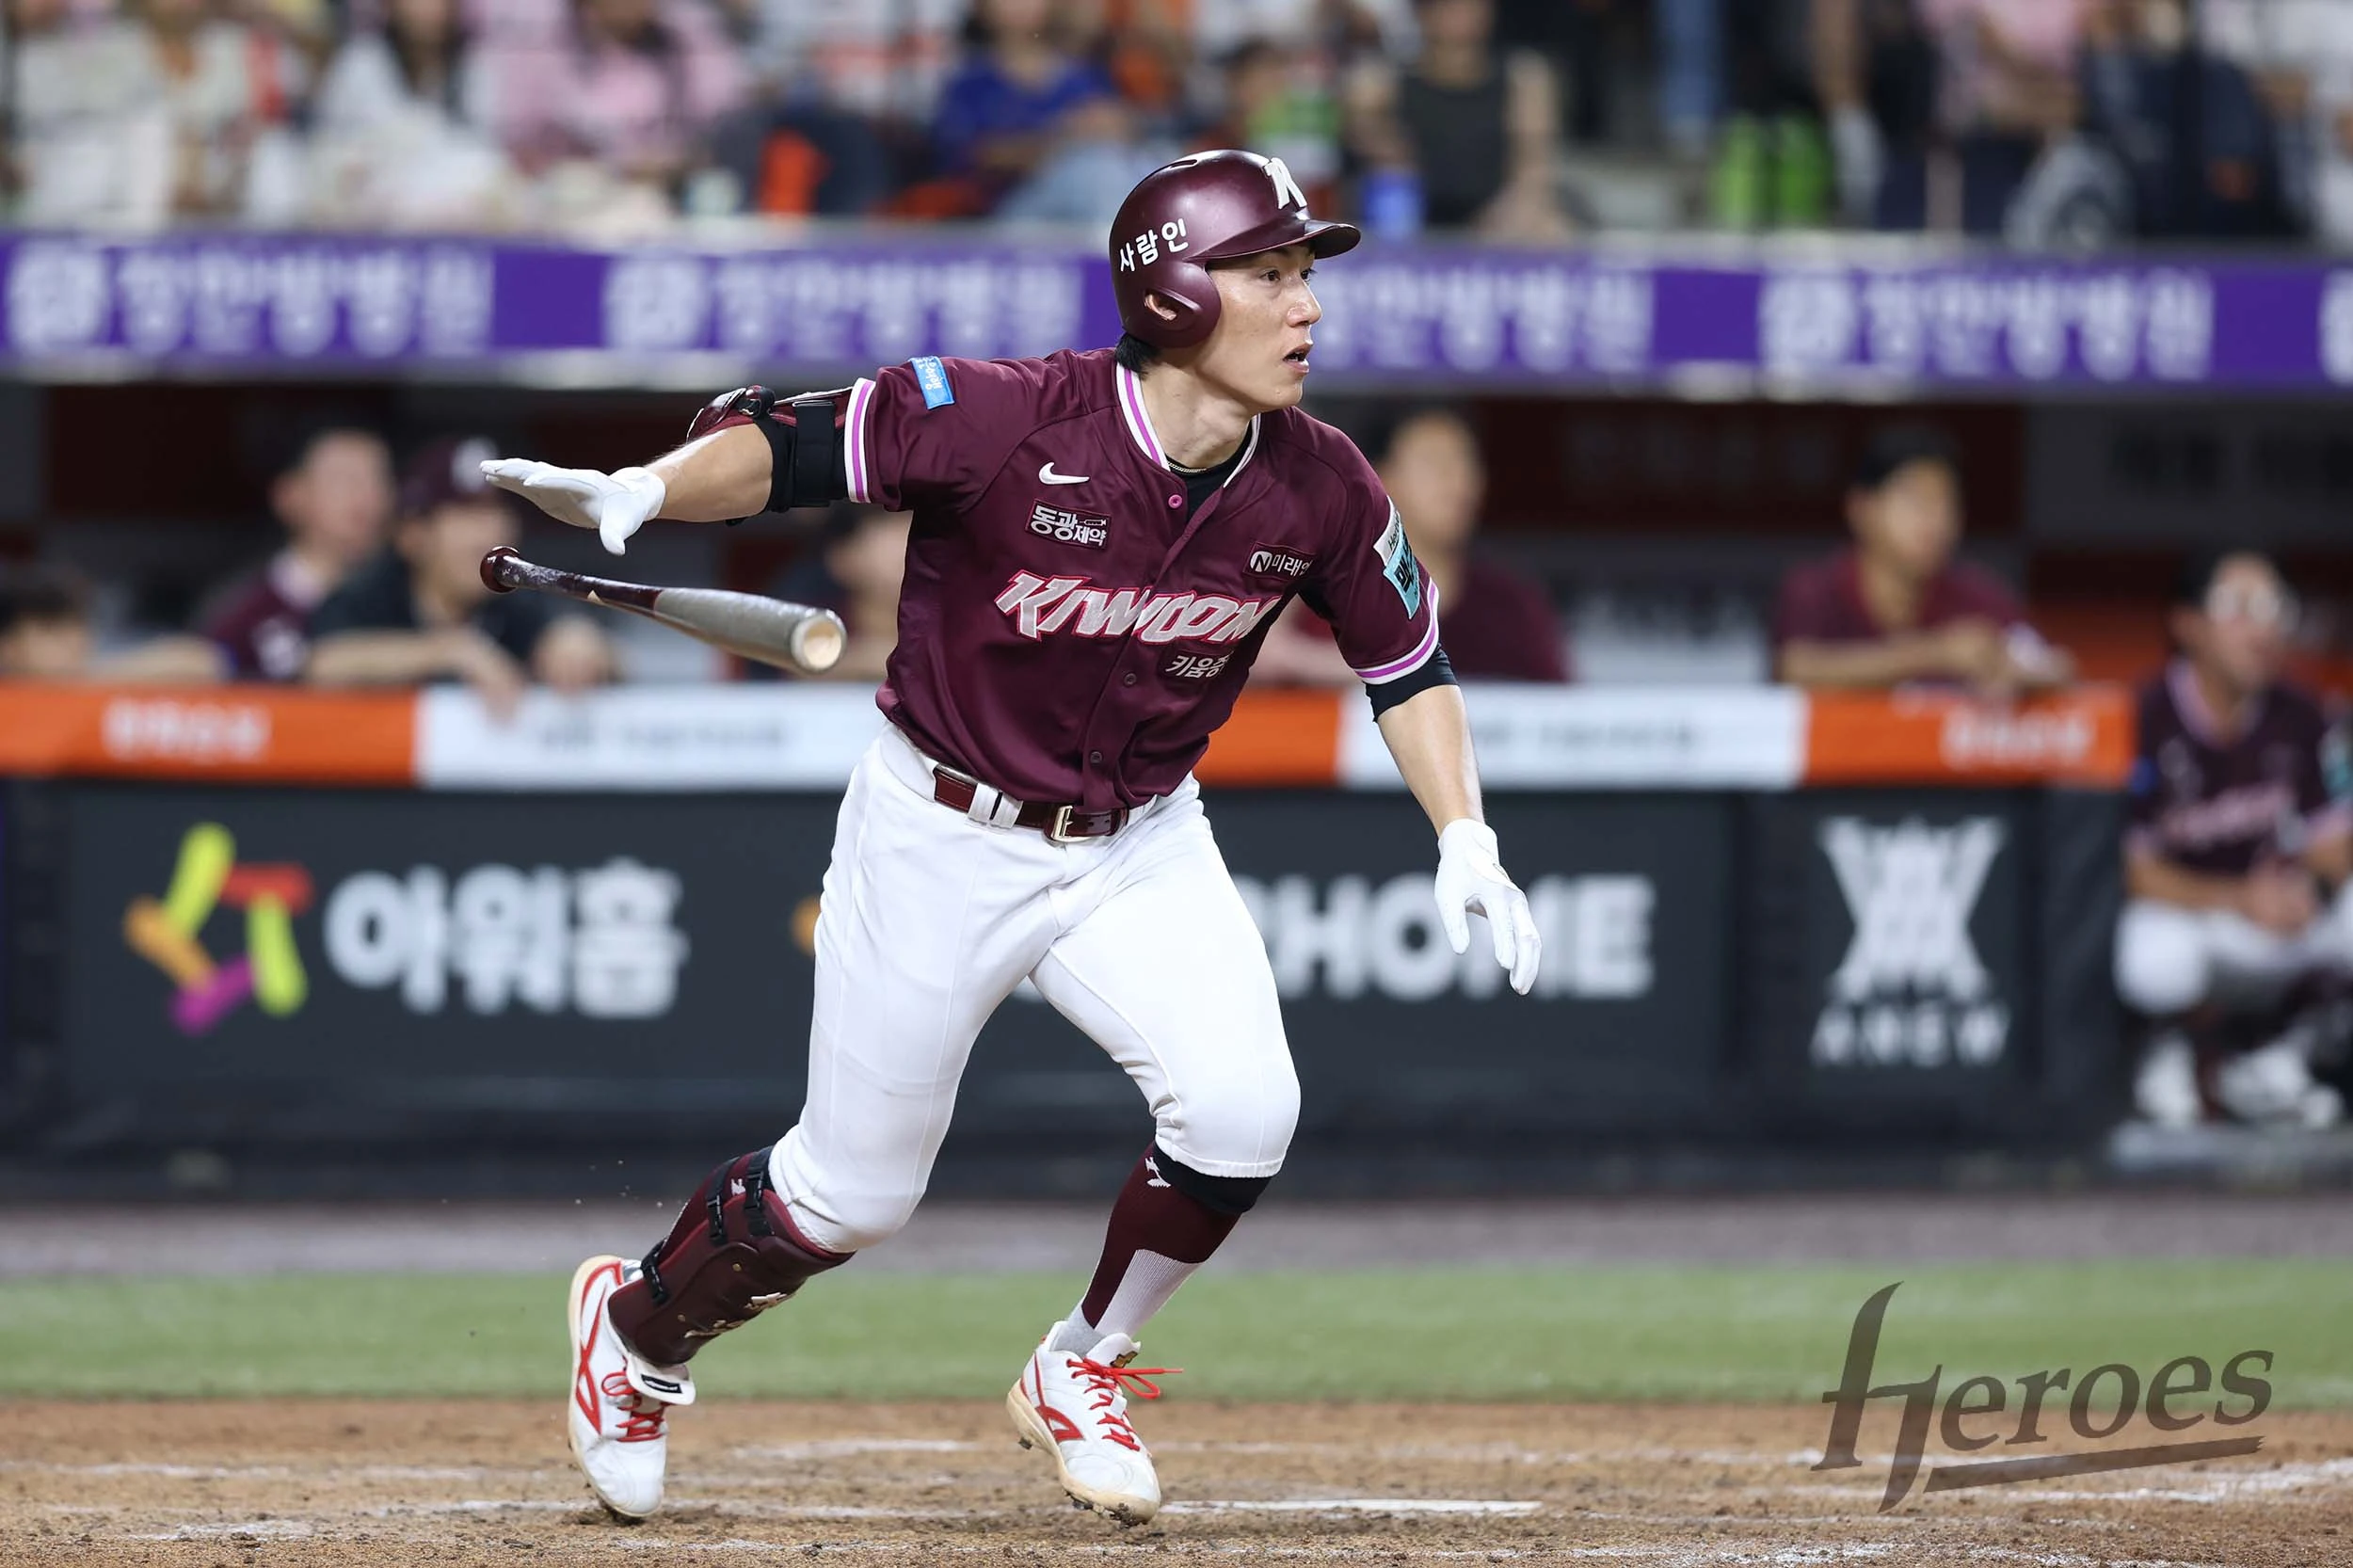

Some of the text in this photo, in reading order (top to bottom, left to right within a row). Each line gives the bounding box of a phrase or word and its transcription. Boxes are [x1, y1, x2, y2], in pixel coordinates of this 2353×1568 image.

[1118, 217, 1190, 273] 사람인
[1031, 505, 1107, 546] 동광제약
[995, 569, 1283, 645] KIWOOM
[324, 856, 689, 1018] 아워홈
